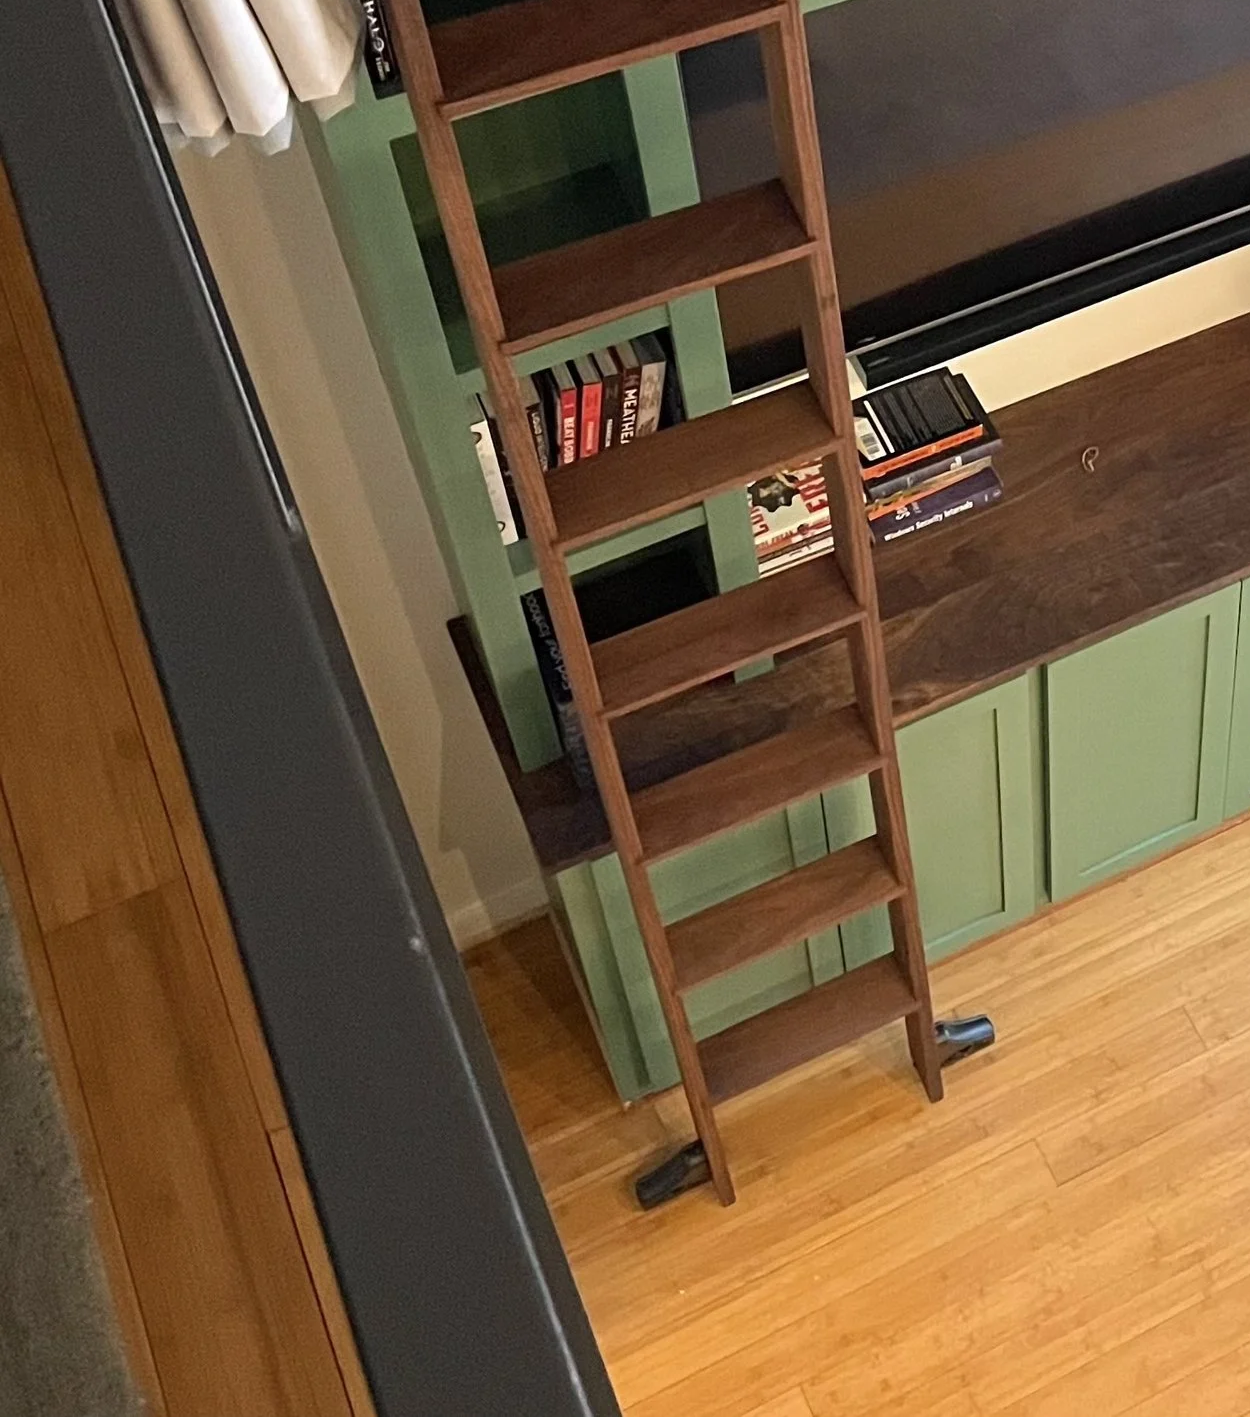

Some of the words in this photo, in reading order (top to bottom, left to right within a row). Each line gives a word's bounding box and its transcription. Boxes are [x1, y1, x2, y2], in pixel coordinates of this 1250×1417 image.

[362, 0, 386, 53] HALO
[883, 525, 915, 542] Windows
[914, 512, 944, 530] Security
[943, 500, 974, 518] Internals
